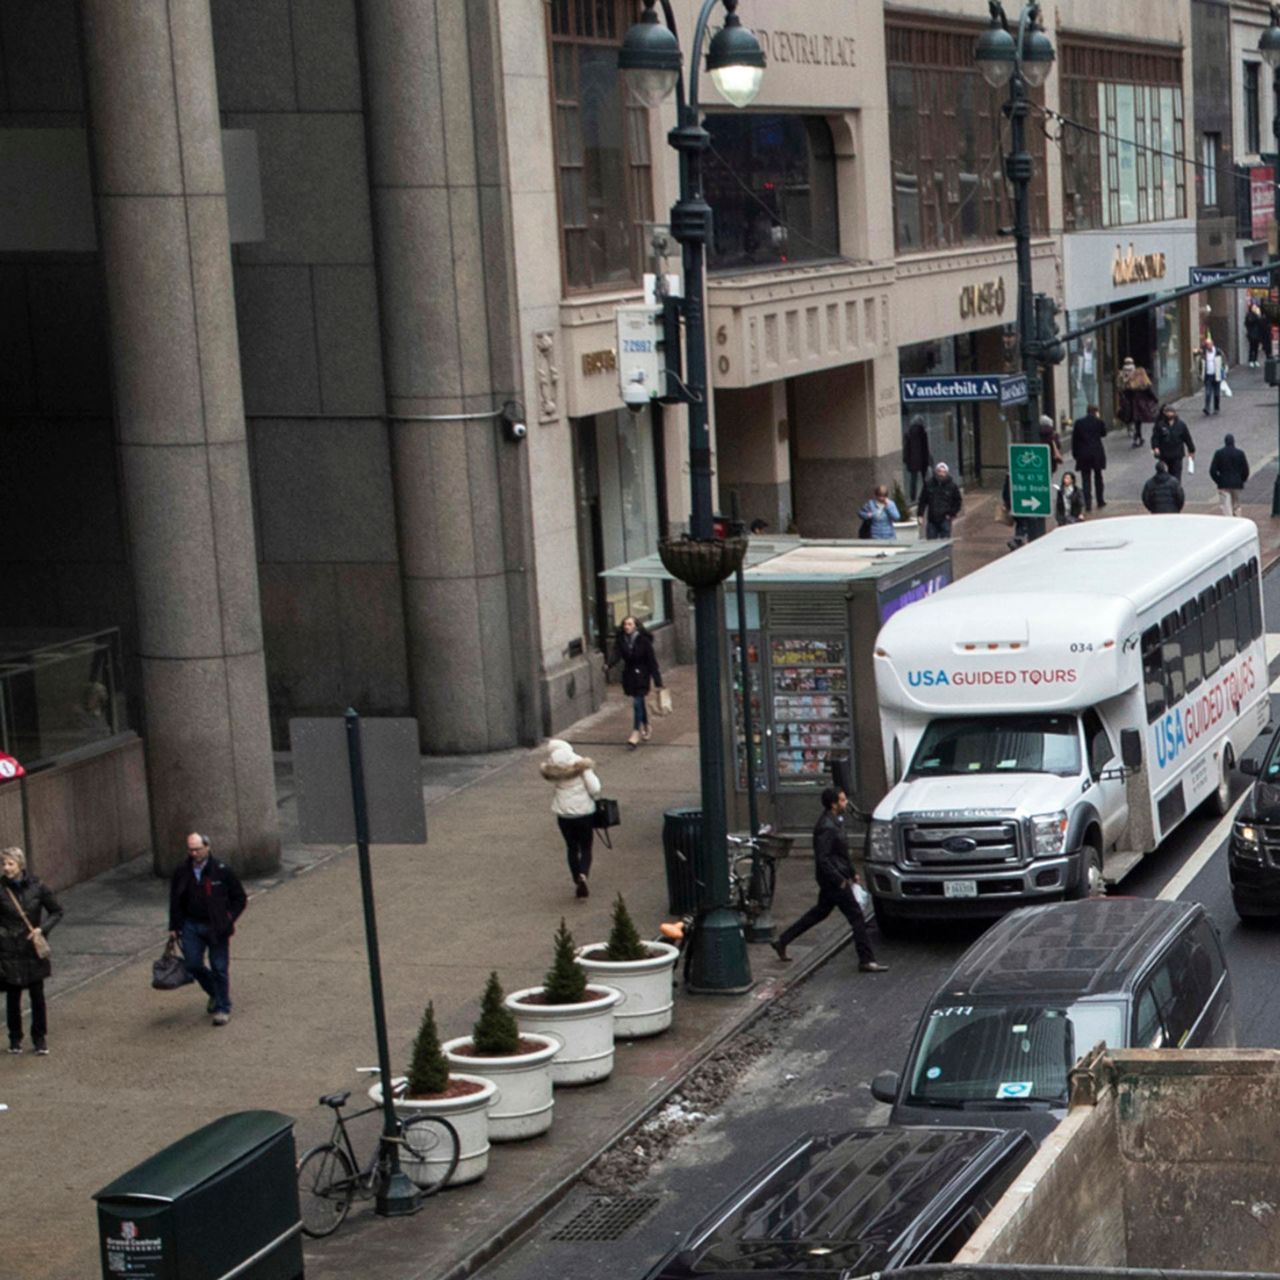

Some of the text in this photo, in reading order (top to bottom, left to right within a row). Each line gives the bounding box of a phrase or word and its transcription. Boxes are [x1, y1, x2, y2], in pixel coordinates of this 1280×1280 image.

[773, 30, 819, 65] CENTRAL
[823, 34, 856, 67] PLACE
[905, 382, 978, 397] Vanderbilt
[1070, 642, 1093, 653] 034
[908, 669, 1077, 687] USA GUIDED TOURS
[1154, 708, 1186, 769] USA
[1184, 685, 1224, 745] GUIDED
[1224, 656, 1256, 711] TOURS
